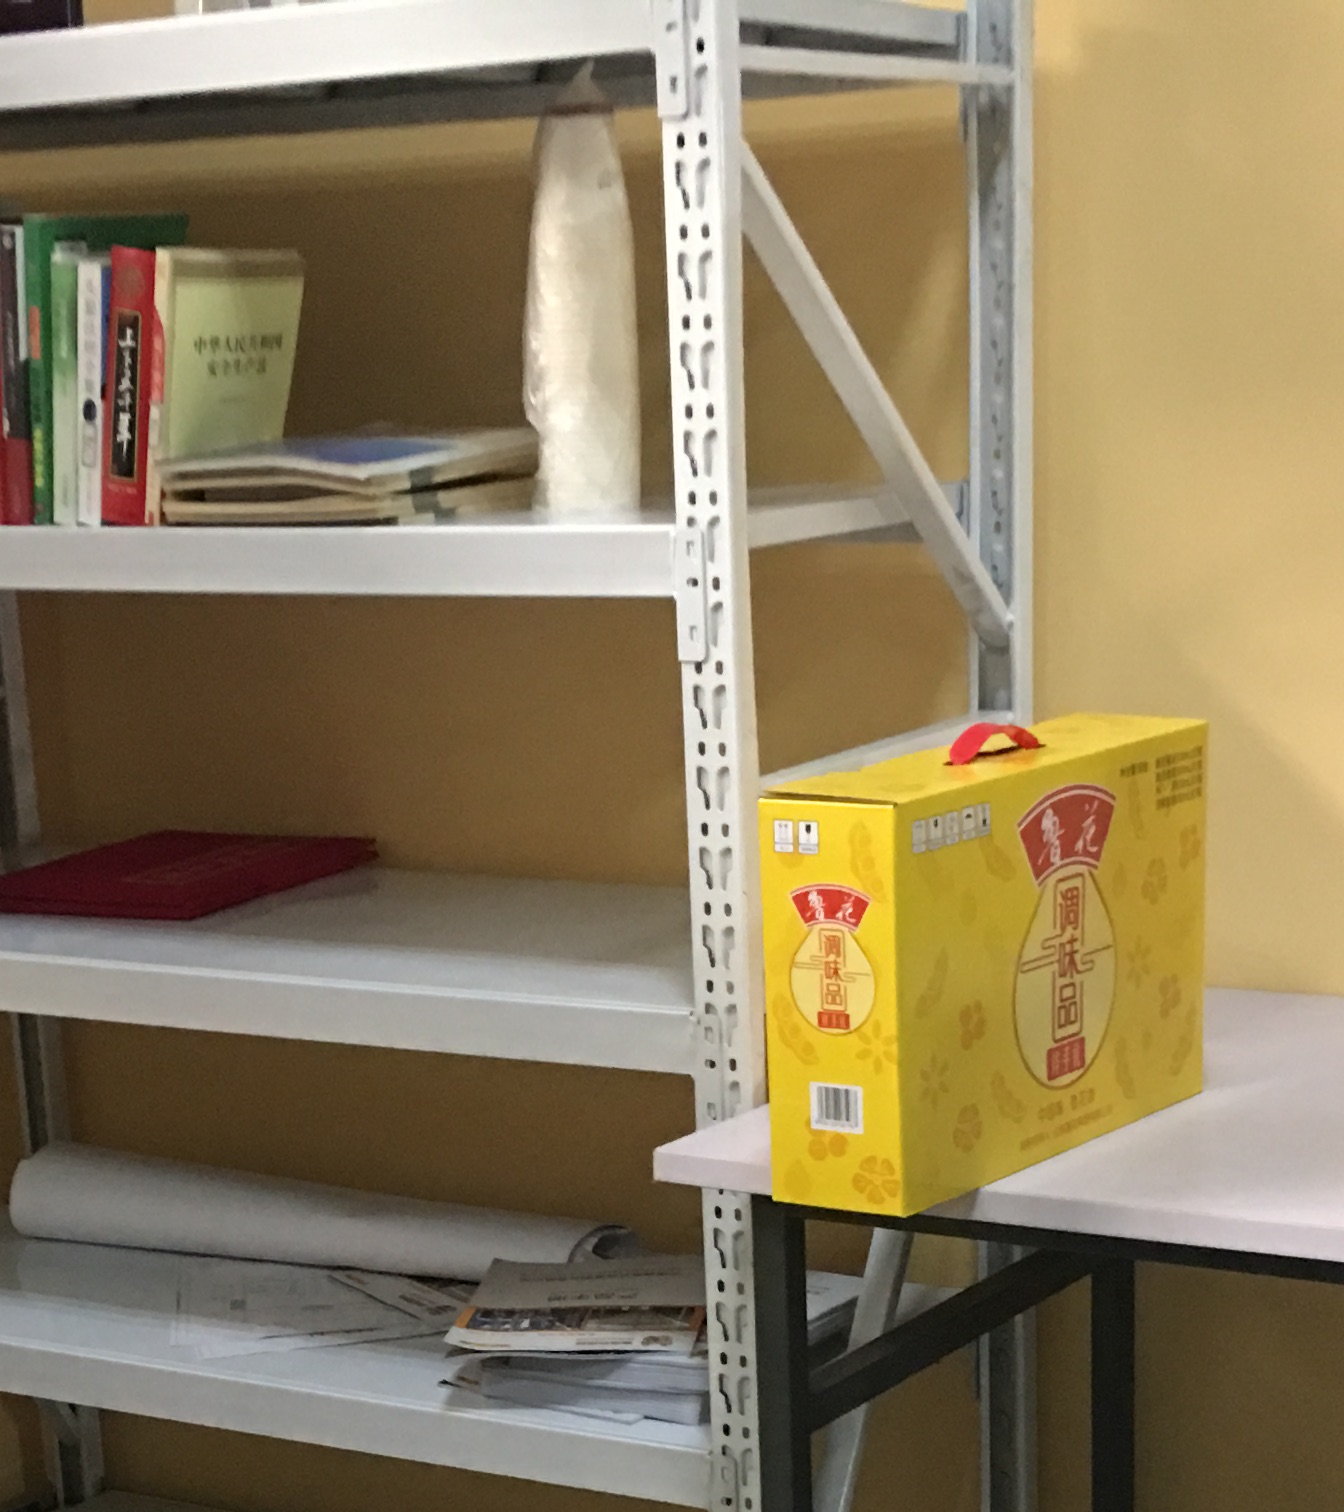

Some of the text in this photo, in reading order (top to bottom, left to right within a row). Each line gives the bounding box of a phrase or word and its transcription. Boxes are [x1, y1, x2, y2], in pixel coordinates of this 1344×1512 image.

[1036, 800, 1102, 867] 鲁花
[806, 890, 857, 923] 鲁花
[823, 934, 844, 1006] 调味品
[1058, 886, 1080, 1030] 调味品
